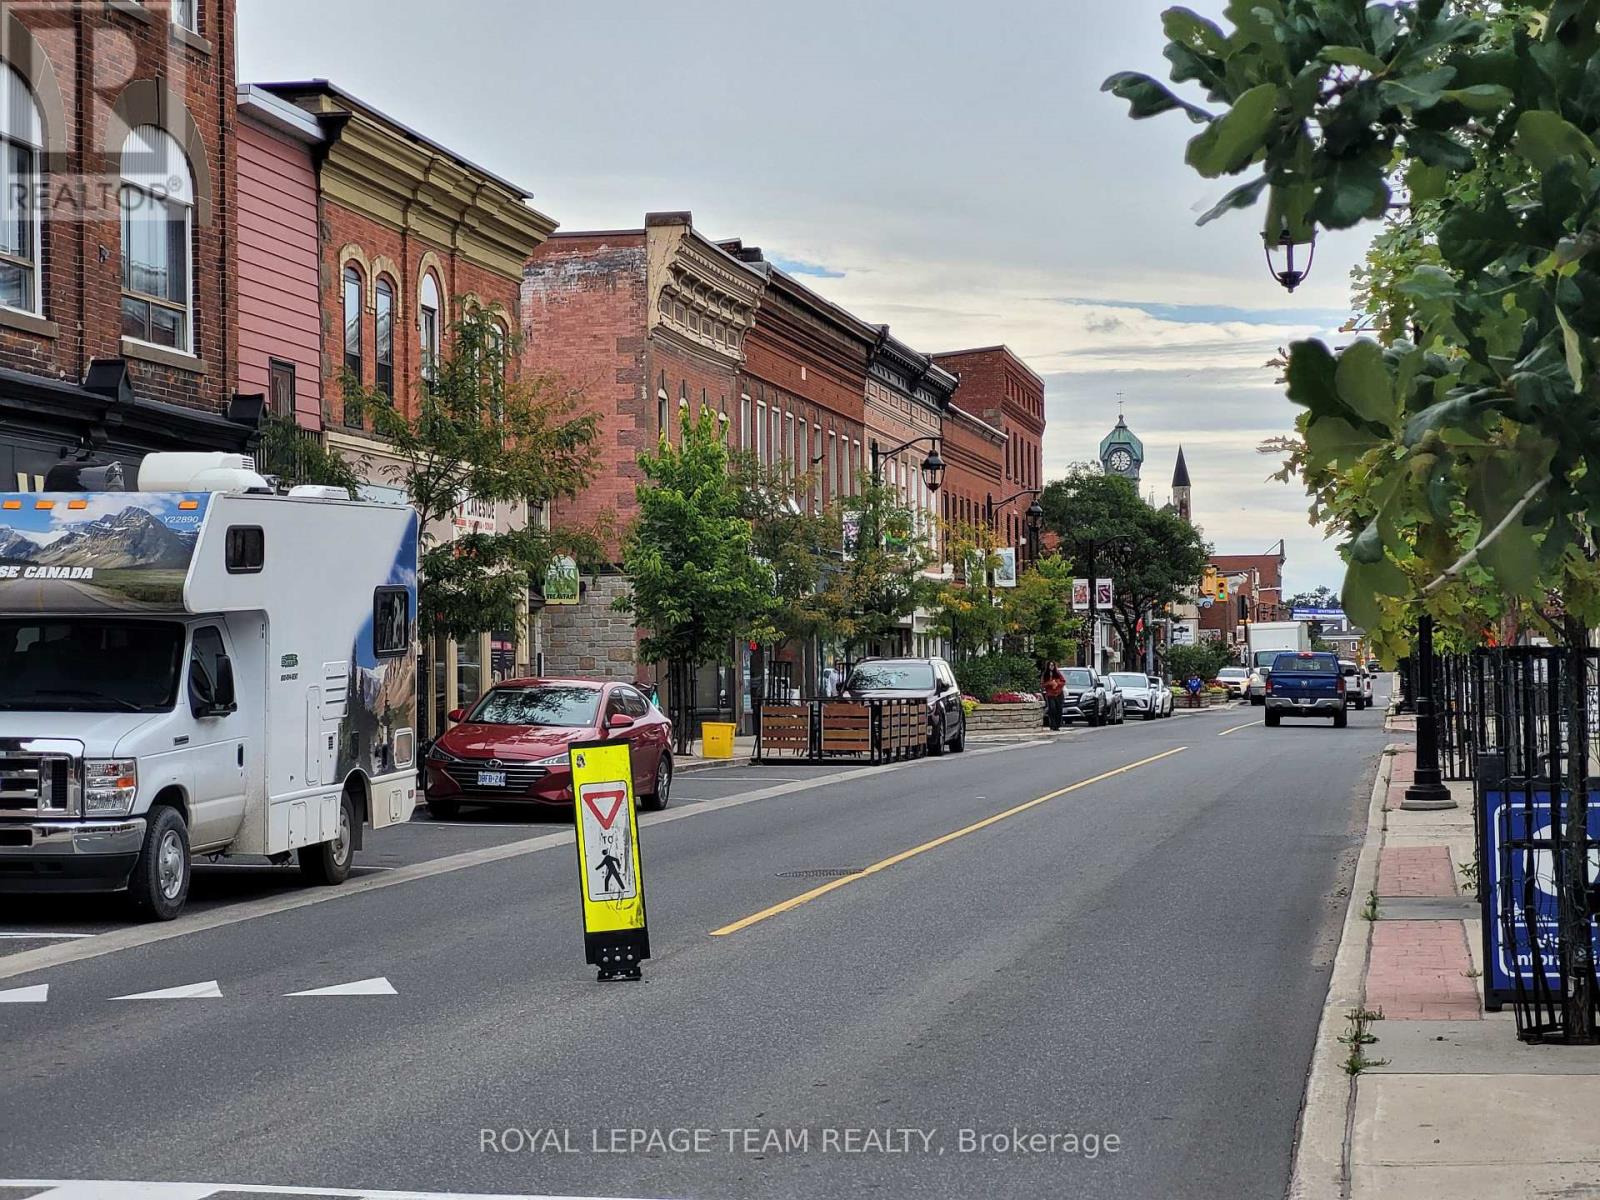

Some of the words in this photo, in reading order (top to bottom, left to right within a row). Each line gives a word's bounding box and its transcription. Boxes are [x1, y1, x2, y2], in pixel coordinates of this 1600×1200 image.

[163, 515, 199, 524] Y22890
[24, 566, 94, 579] CANADA
[602, 835, 614, 845] TO
